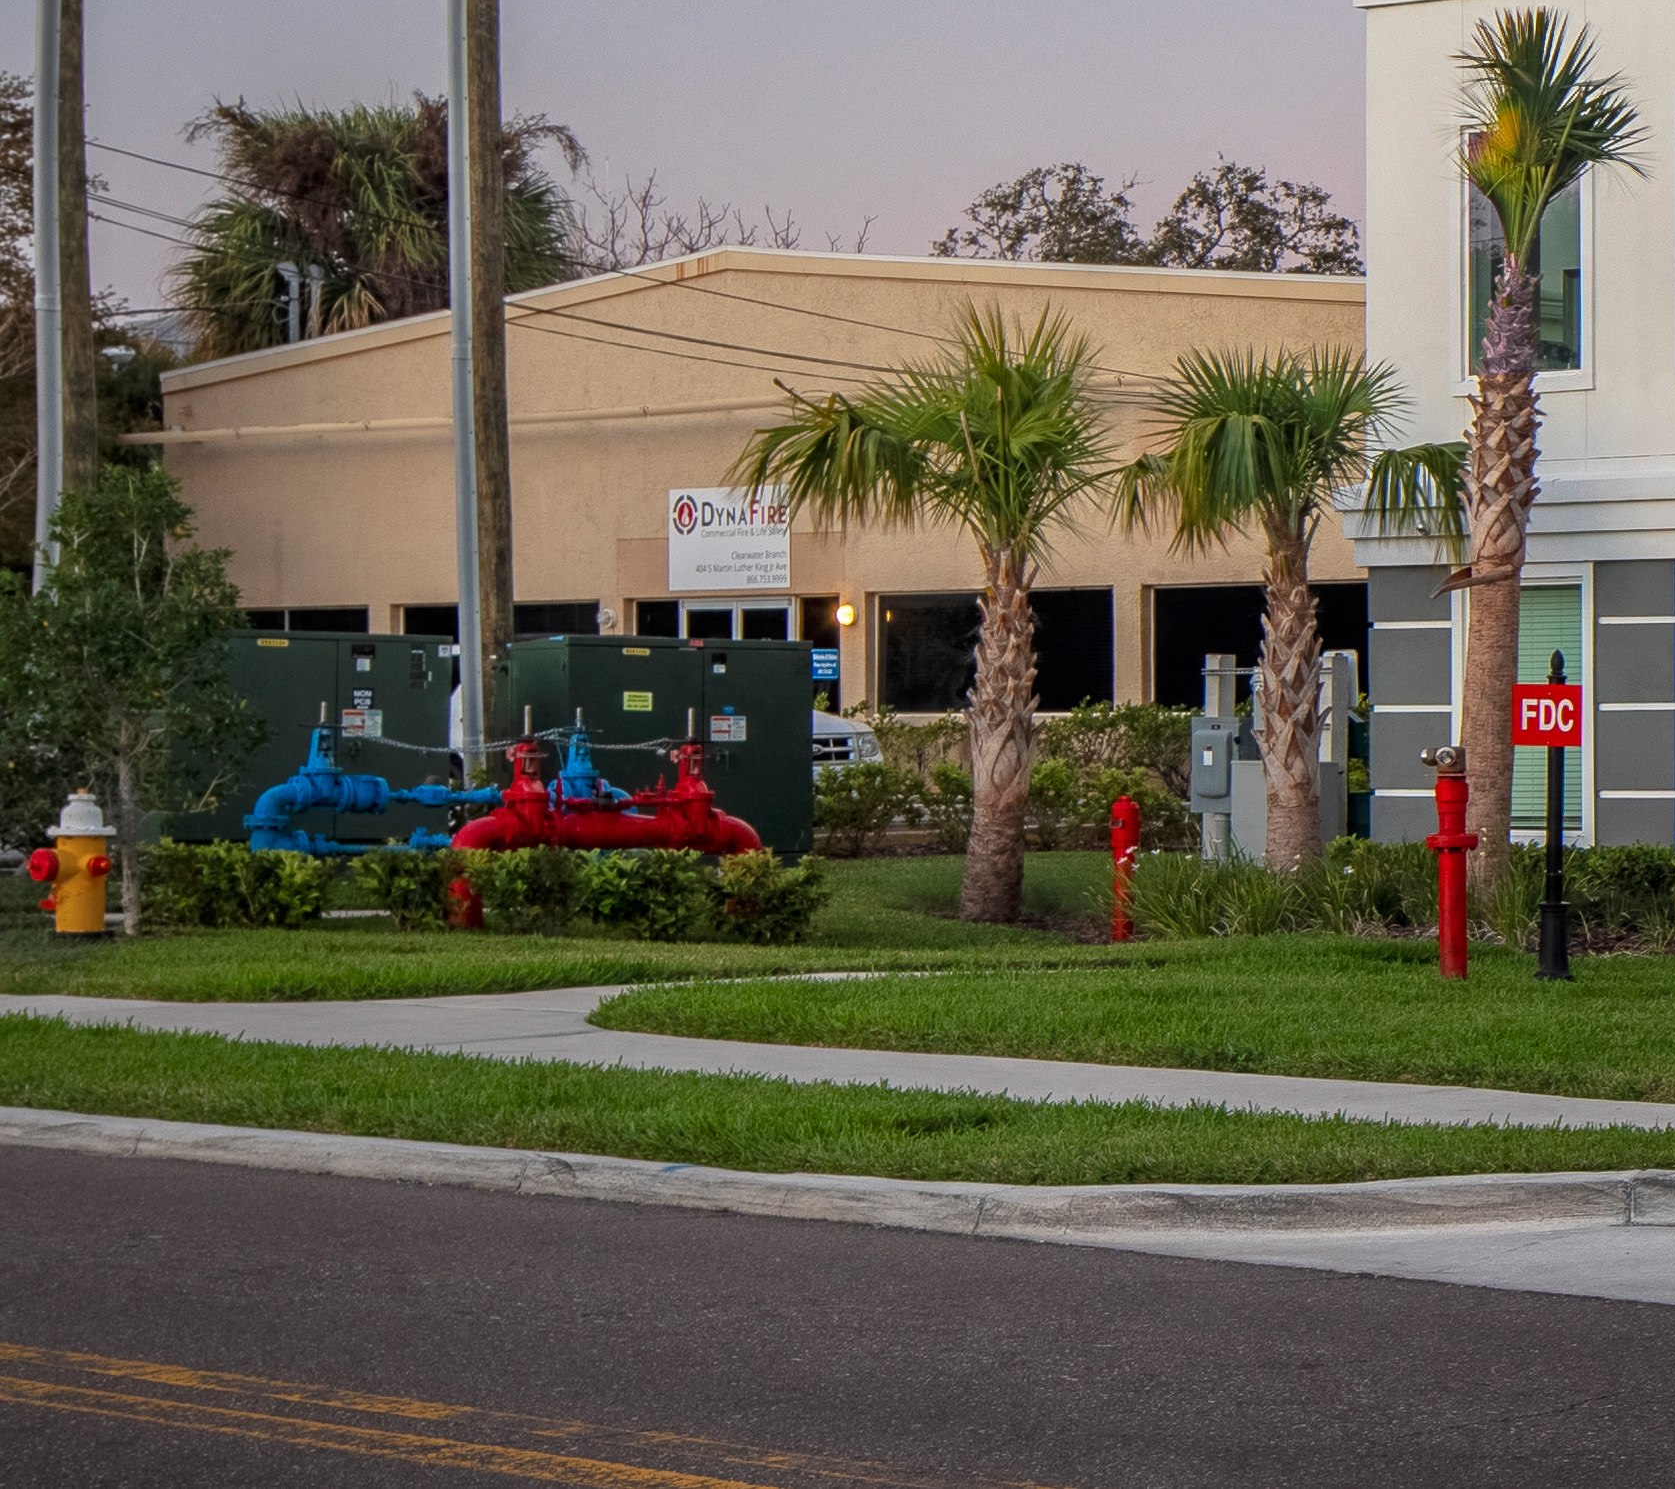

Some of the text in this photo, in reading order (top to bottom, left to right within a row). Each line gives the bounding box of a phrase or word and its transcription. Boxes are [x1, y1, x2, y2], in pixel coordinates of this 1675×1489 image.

[701, 528, 736, 538] Commercial
[738, 528, 749, 537] Fire
[731, 550, 786, 560] Clearwater Branch
[713, 564, 733, 573] Martin
[734, 563, 754, 572] Luther
[755, 563, 768, 573] King
[1521, 698, 1574, 732] FDC
